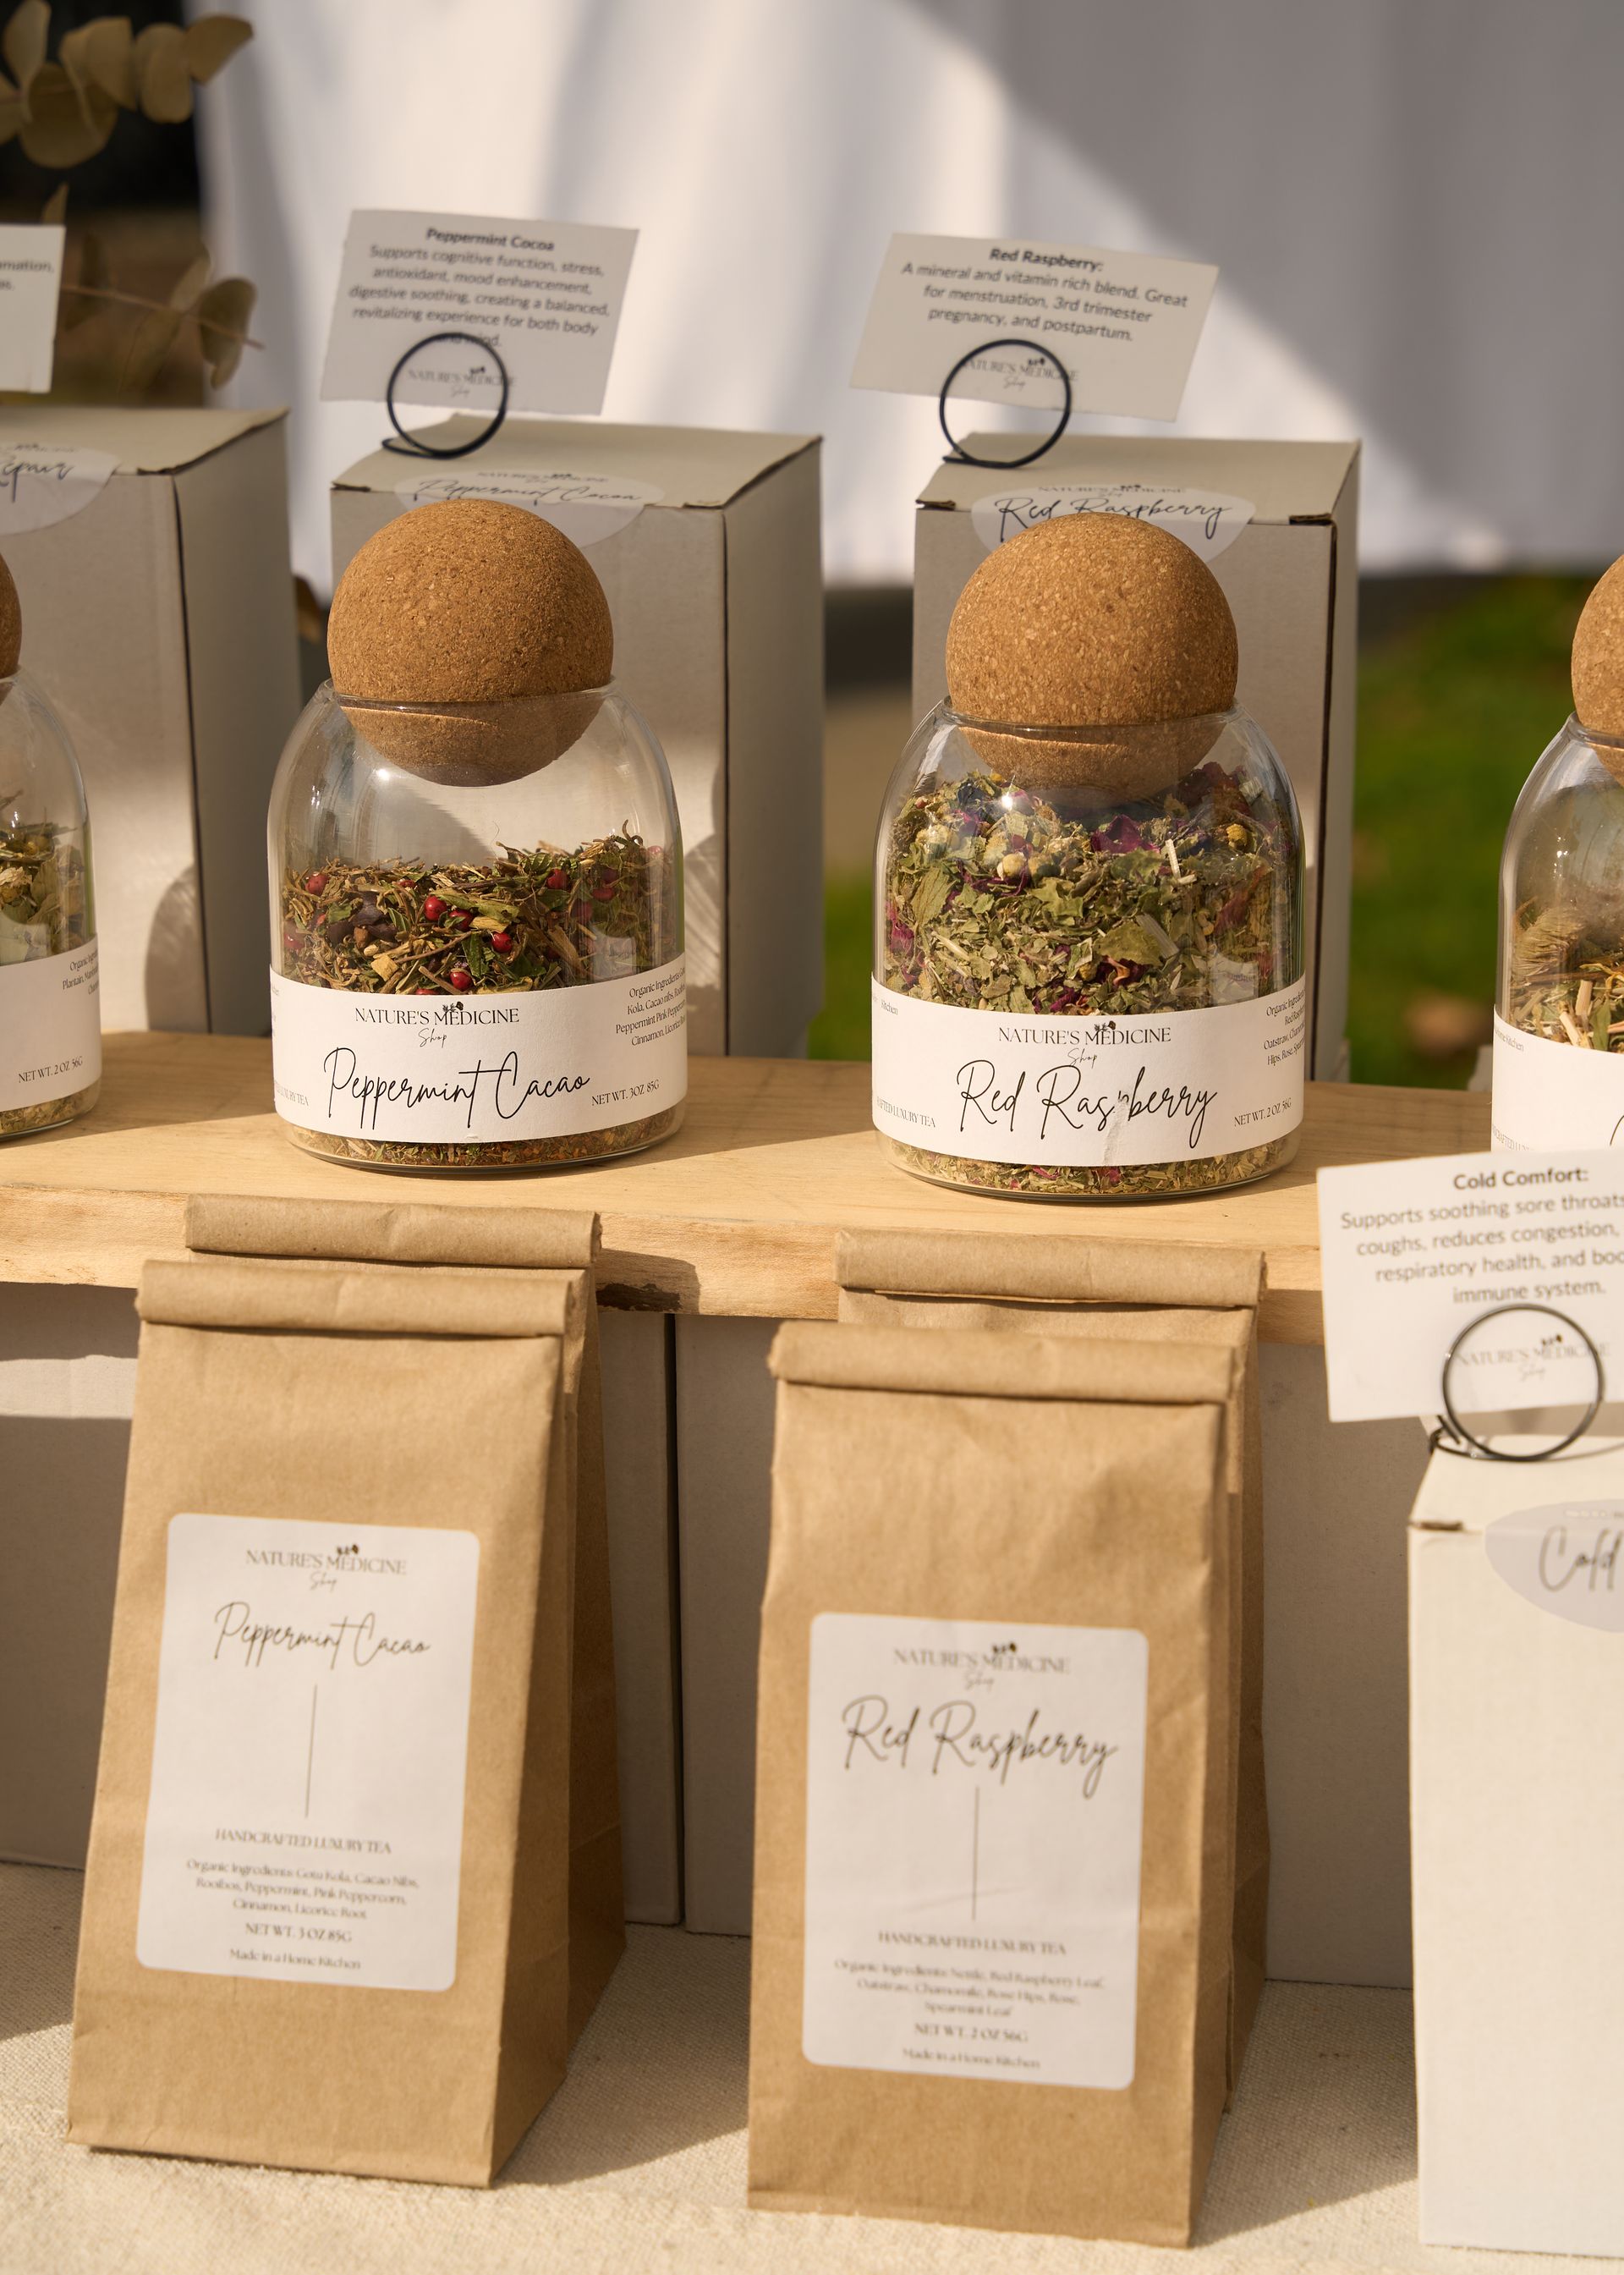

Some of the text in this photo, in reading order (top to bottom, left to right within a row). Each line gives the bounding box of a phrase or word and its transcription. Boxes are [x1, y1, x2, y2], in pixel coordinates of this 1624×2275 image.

[426, 228, 555, 251] Peppermint Cocoa
[370, 245, 605, 277] Supports cognitive function, stress,
[990, 248, 1104, 272] Red Raspberry:
[373, 267, 592, 294] antioxidant, mood enhancement,
[900, 262, 1188, 308] A mineral and vitamin rich blend. Great
[349, 285, 610, 316] digestive soothing, creating a balanced,
[923, 284, 1153, 322] for menstruation, 3rd trimester
[353, 307, 599, 336] revitalizing experience for both body
[927, 308, 1133, 342] pregnancy, and postpartum.
[994, 497, 1234, 543] Red Raspberry
[628, 983, 656, 998] Organic
[645, 997, 664, 1009] Cacao
[354, 1008, 520, 1025] NATURE'S MEDICINE
[418, 1028, 447, 1048] Shop
[998, 1027, 1171, 1046] NATURE'S MEDICINE
[1067, 1047, 1098, 1069] Shop
[19, 1069, 36, 1083] NET
[37, 1066, 53, 1078] WT.
[53, 1064, 59, 1074] 2
[59, 1060, 70, 1073] OZ
[324, 1047, 590, 1130] Peppermint Cacao
[591, 1092, 611, 1106] NET
[612, 1089, 628, 1102] WT.
[646, 1079, 660, 1092] 85G
[957, 1059, 1026, 1132] Red
[919, 1113, 936, 1128] TEA
[1234, 1113, 1251, 1127] NET
[1252, 1108, 1266, 1121] WT.
[1266, 1107, 1271, 1118] 2
[1271, 1102, 1281, 1115] OZ
[1453, 1168, 1588, 1190] Cold Comfort:
[1341, 1199, 1555, 1230] Supports soothing sore
[1356, 1221, 1620, 1256] coughs, reduces congestion,
[1375, 1261, 1477, 1283] respiratory
[1482, 1252, 1546, 1273] health,
[1551, 1250, 1586, 1268] and
[1453, 1280, 1606, 1304] immune system.
[326, 1554, 407, 1575] MEDICINE
[310, 1571, 337, 1591] Shop
[214, 1601, 431, 1671] Peppermint Cacao
[981, 1651, 1071, 1675] MEDICINE
[842, 1695, 1119, 1800] Red Raspberry
[215, 1828, 392, 1855] HANDCRAFTED LUXURY TEA
[186, 1858, 229, 1873] Organic
[354, 1873, 391, 1885] Cacao
[314, 1887, 337, 1899] Pink
[232, 1898, 293, 1914] Cinnamon,
[294, 1904, 338, 1918] Licorice
[245, 1922, 270, 1936] NET
[299, 1926, 305, 1941] 3
[307, 1927, 326, 1942] OZ
[328, 1929, 353, 1943] 85G
[878, 1930, 982, 1949] HANDCRAFTED
[1040, 1941, 1067, 1955] TEA
[229, 1948, 361, 1970] Made in a Home Kitchen
[914, 2022, 940, 2036] NET
